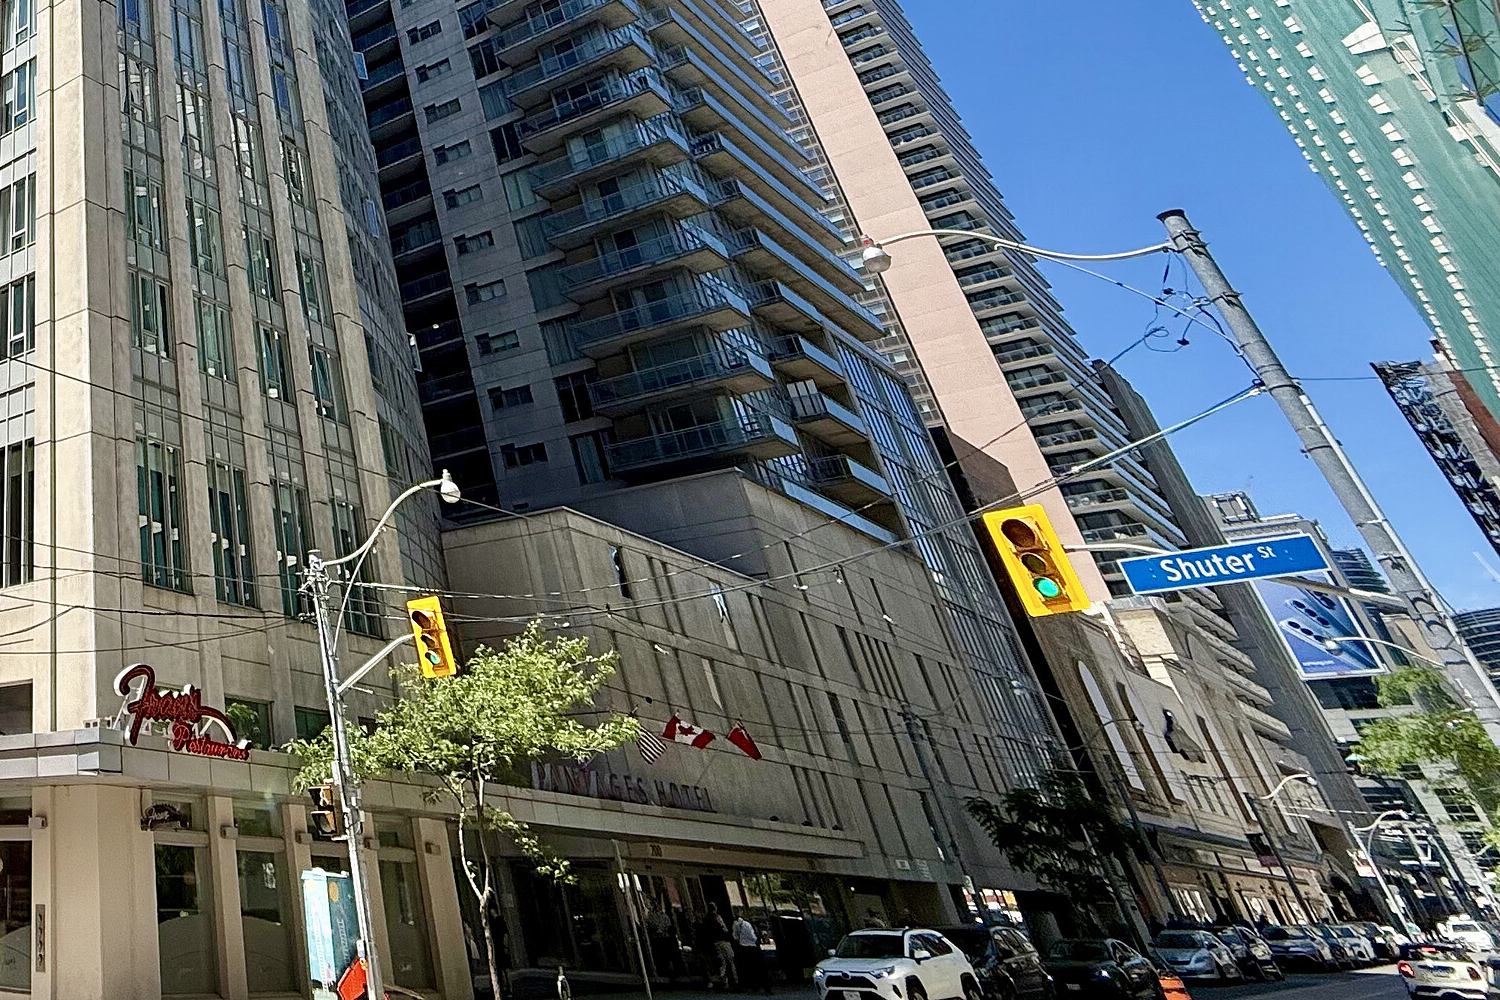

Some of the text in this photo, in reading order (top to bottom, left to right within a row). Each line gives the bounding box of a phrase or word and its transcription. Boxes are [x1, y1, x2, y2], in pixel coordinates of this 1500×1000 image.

[1160, 545, 1277, 582] Shuter St
[653, 779, 717, 813] HOTEL
